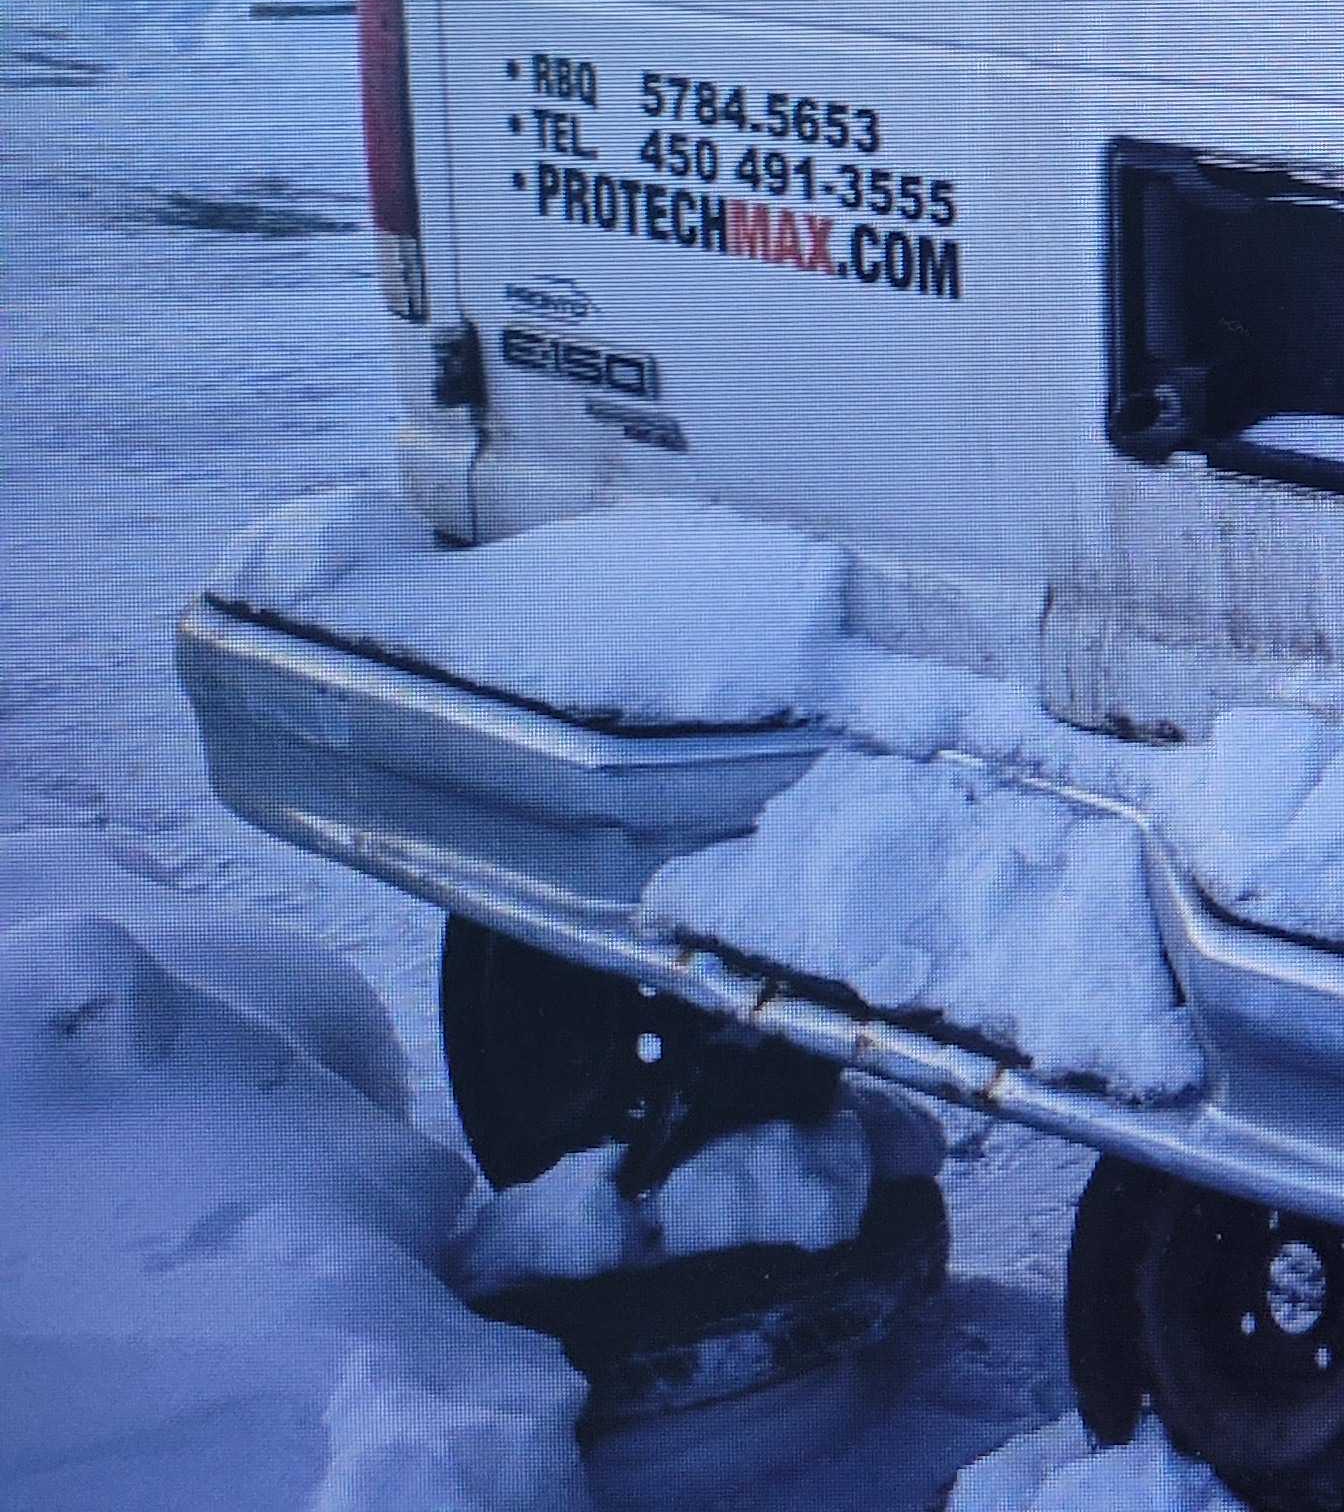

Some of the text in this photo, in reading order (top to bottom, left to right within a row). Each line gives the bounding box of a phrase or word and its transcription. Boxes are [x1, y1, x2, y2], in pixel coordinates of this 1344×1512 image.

[531, 53, 600, 109] RBQ
[639, 127, 721, 184] 450
[735, 145, 958, 228] 491-3555
[535, 159, 963, 301] PROTECHMAX.COM
